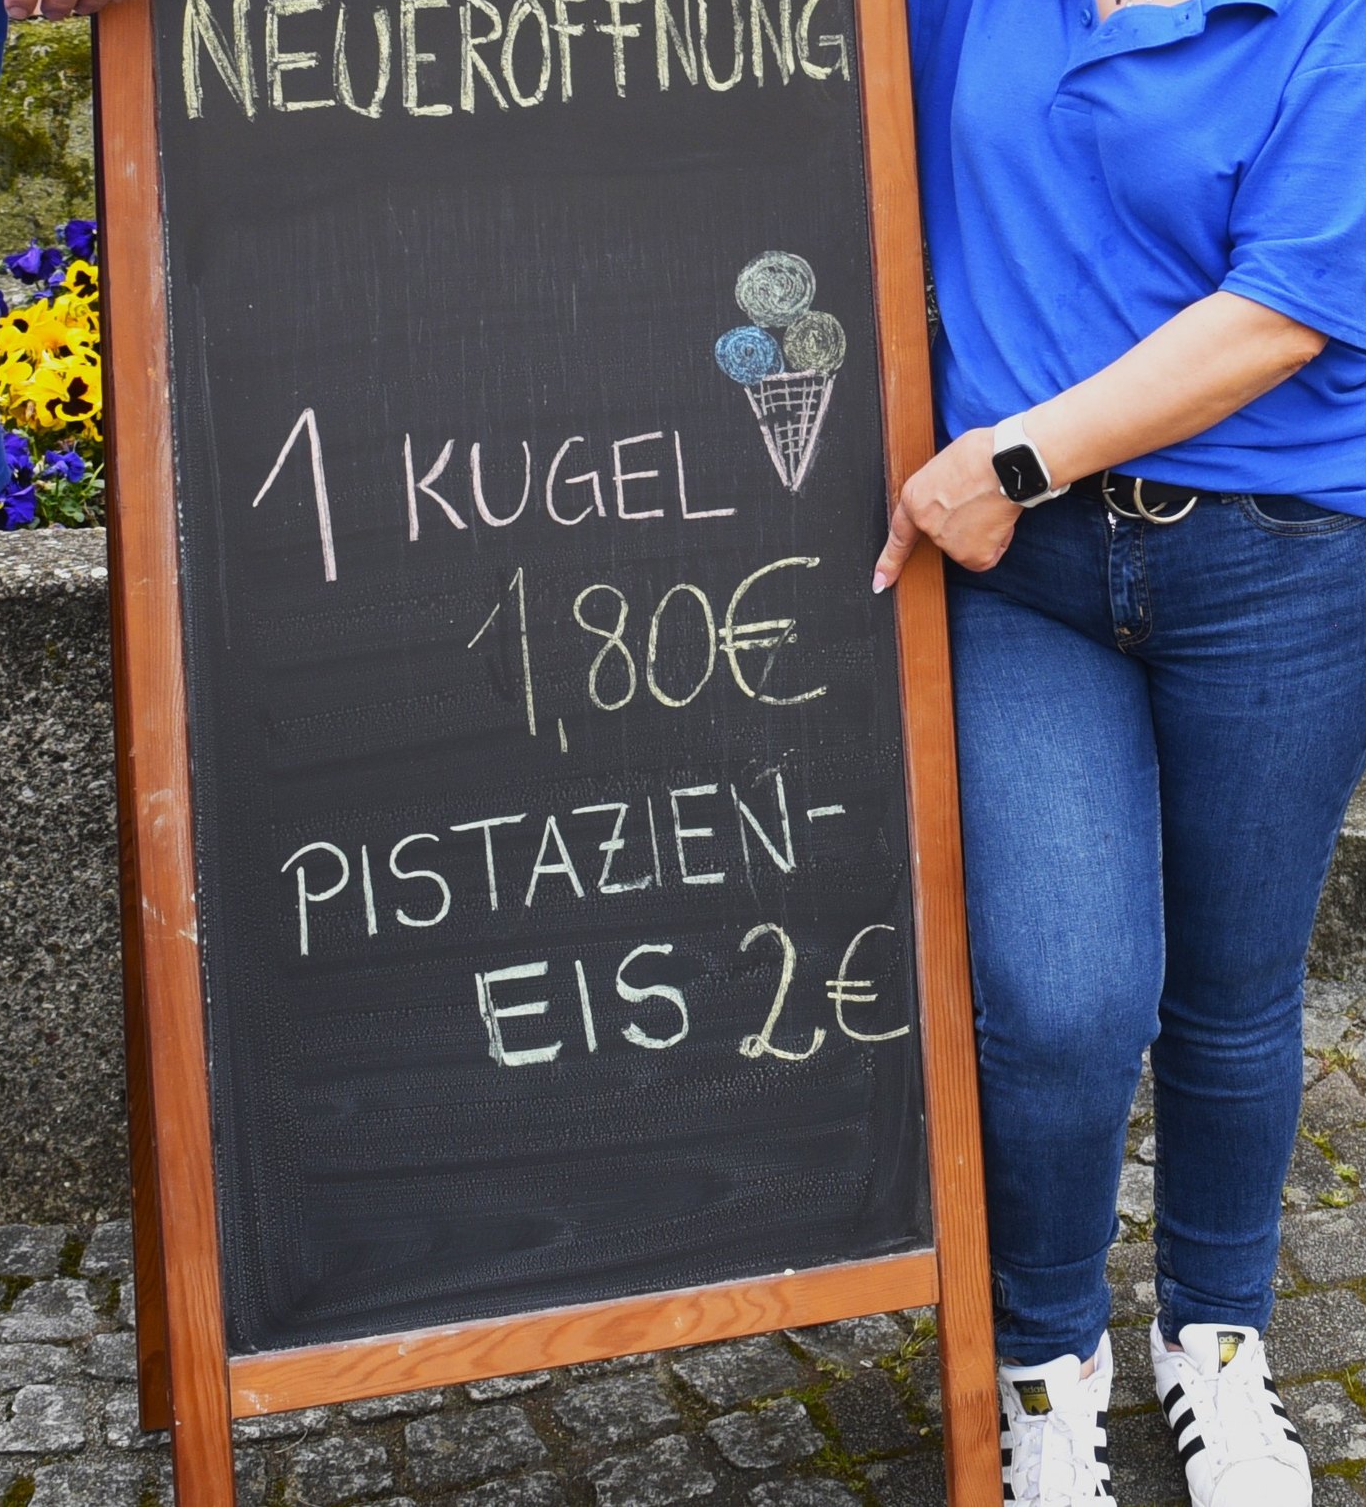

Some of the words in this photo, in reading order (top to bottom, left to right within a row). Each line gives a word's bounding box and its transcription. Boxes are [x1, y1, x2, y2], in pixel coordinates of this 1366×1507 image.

[252, 407, 337, 582] 1
[403, 429, 737, 542] KUGEL
[467, 556, 827, 754] 1,80€
[280, 771, 846, 957] PISTAZIEN-
[474, 943, 690, 1067] EIS
